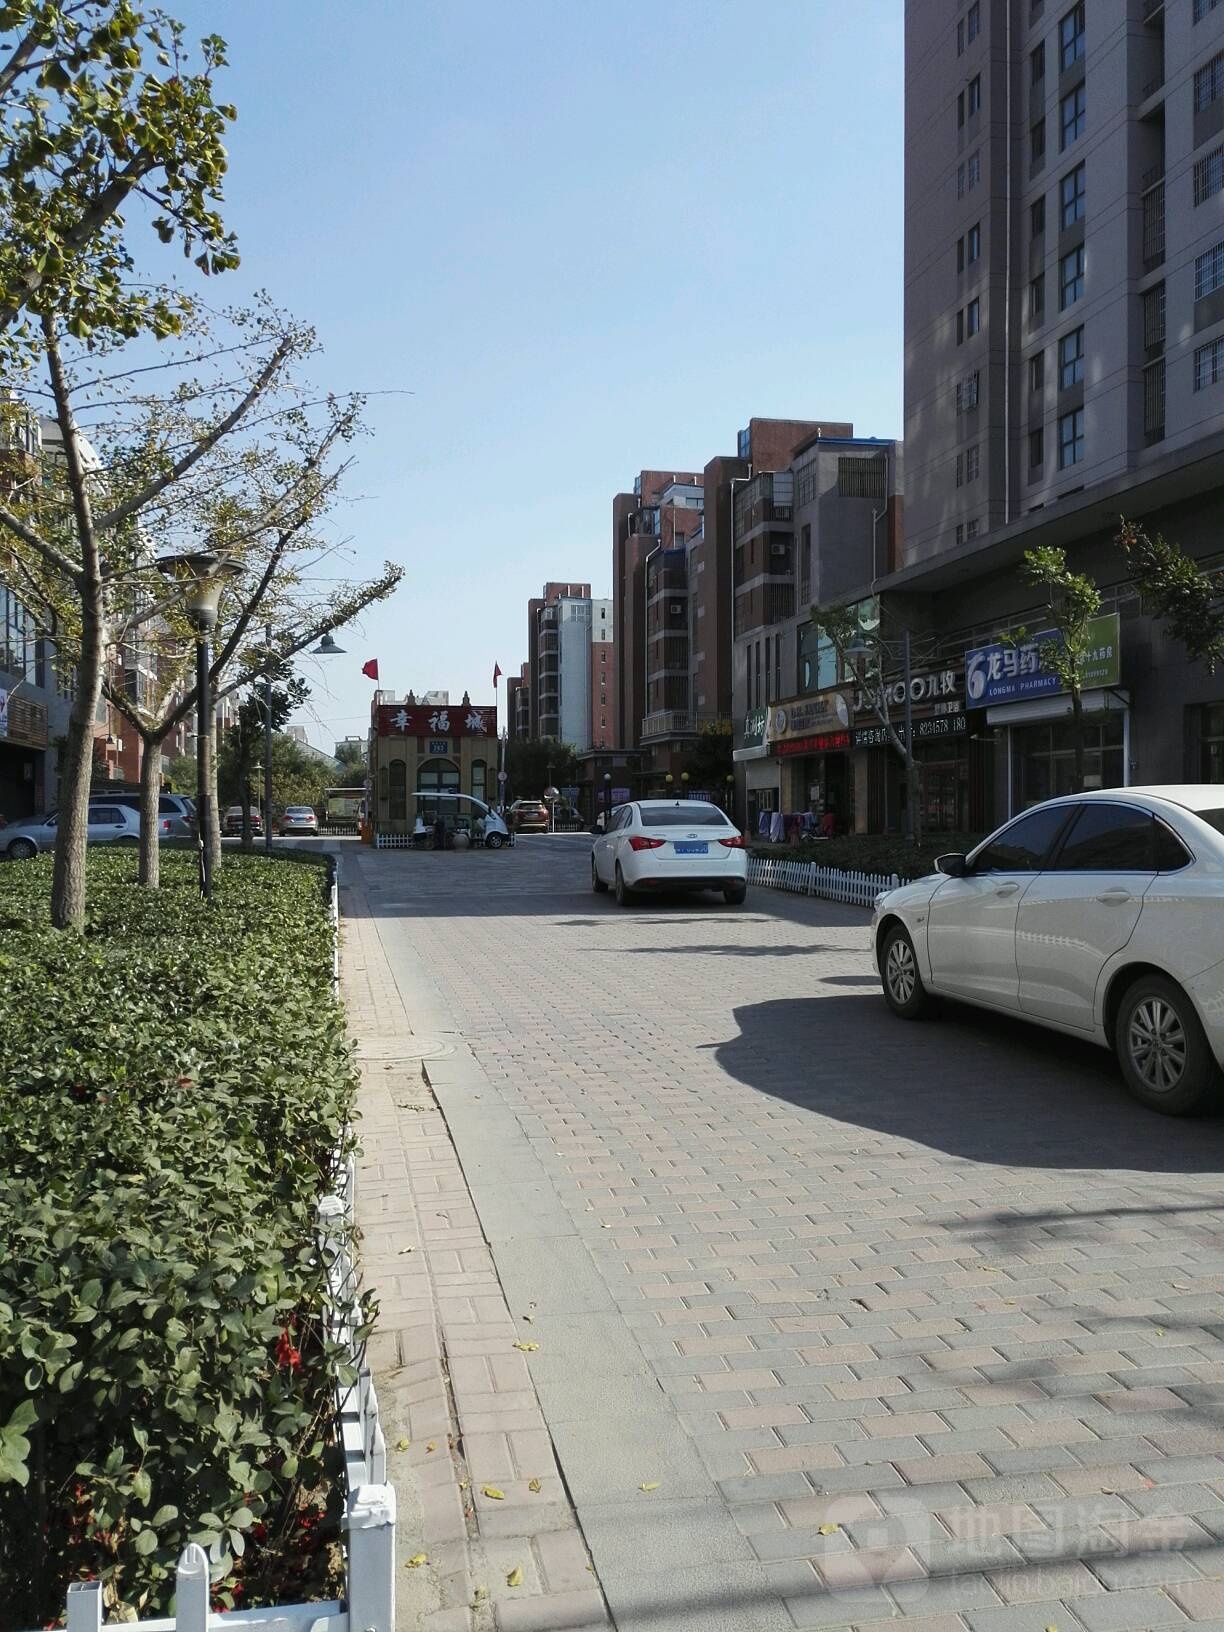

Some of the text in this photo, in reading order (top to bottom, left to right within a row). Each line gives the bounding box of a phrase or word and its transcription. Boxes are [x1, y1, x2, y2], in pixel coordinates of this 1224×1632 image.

[987, 642, 1052, 681] 龙马药
[989, 676, 1057, 697] LONGMA PHARMACY
[390, 708, 488, 733] 幸福城
[953, 716, 967, 732] 180
